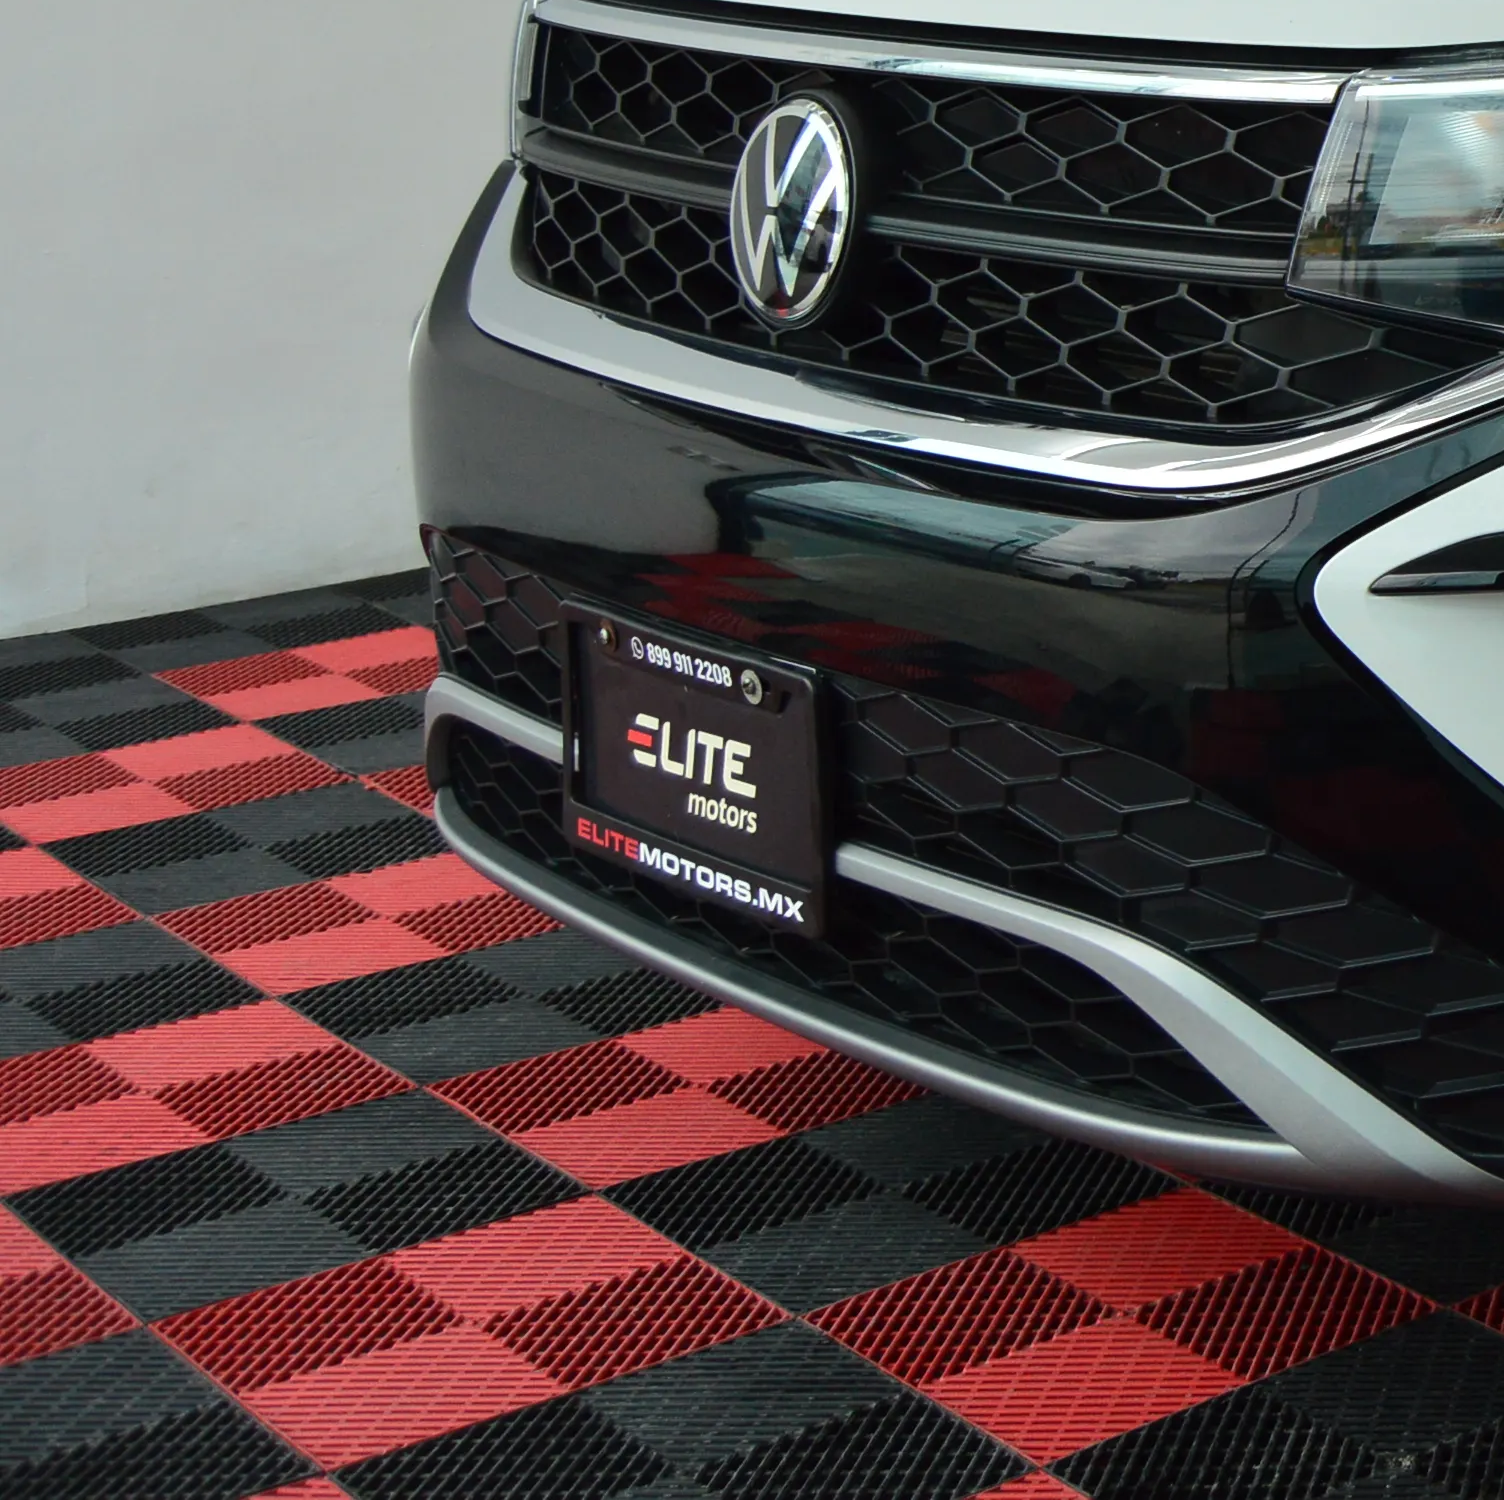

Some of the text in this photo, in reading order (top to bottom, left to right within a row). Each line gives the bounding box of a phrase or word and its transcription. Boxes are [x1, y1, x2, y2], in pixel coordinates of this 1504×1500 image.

[646, 642, 733, 688] 899 911 2208
[627, 713, 757, 799] ELITE
[687, 792, 758, 834] motors
[576, 817, 805, 923] ELITEMOTORS.MX
